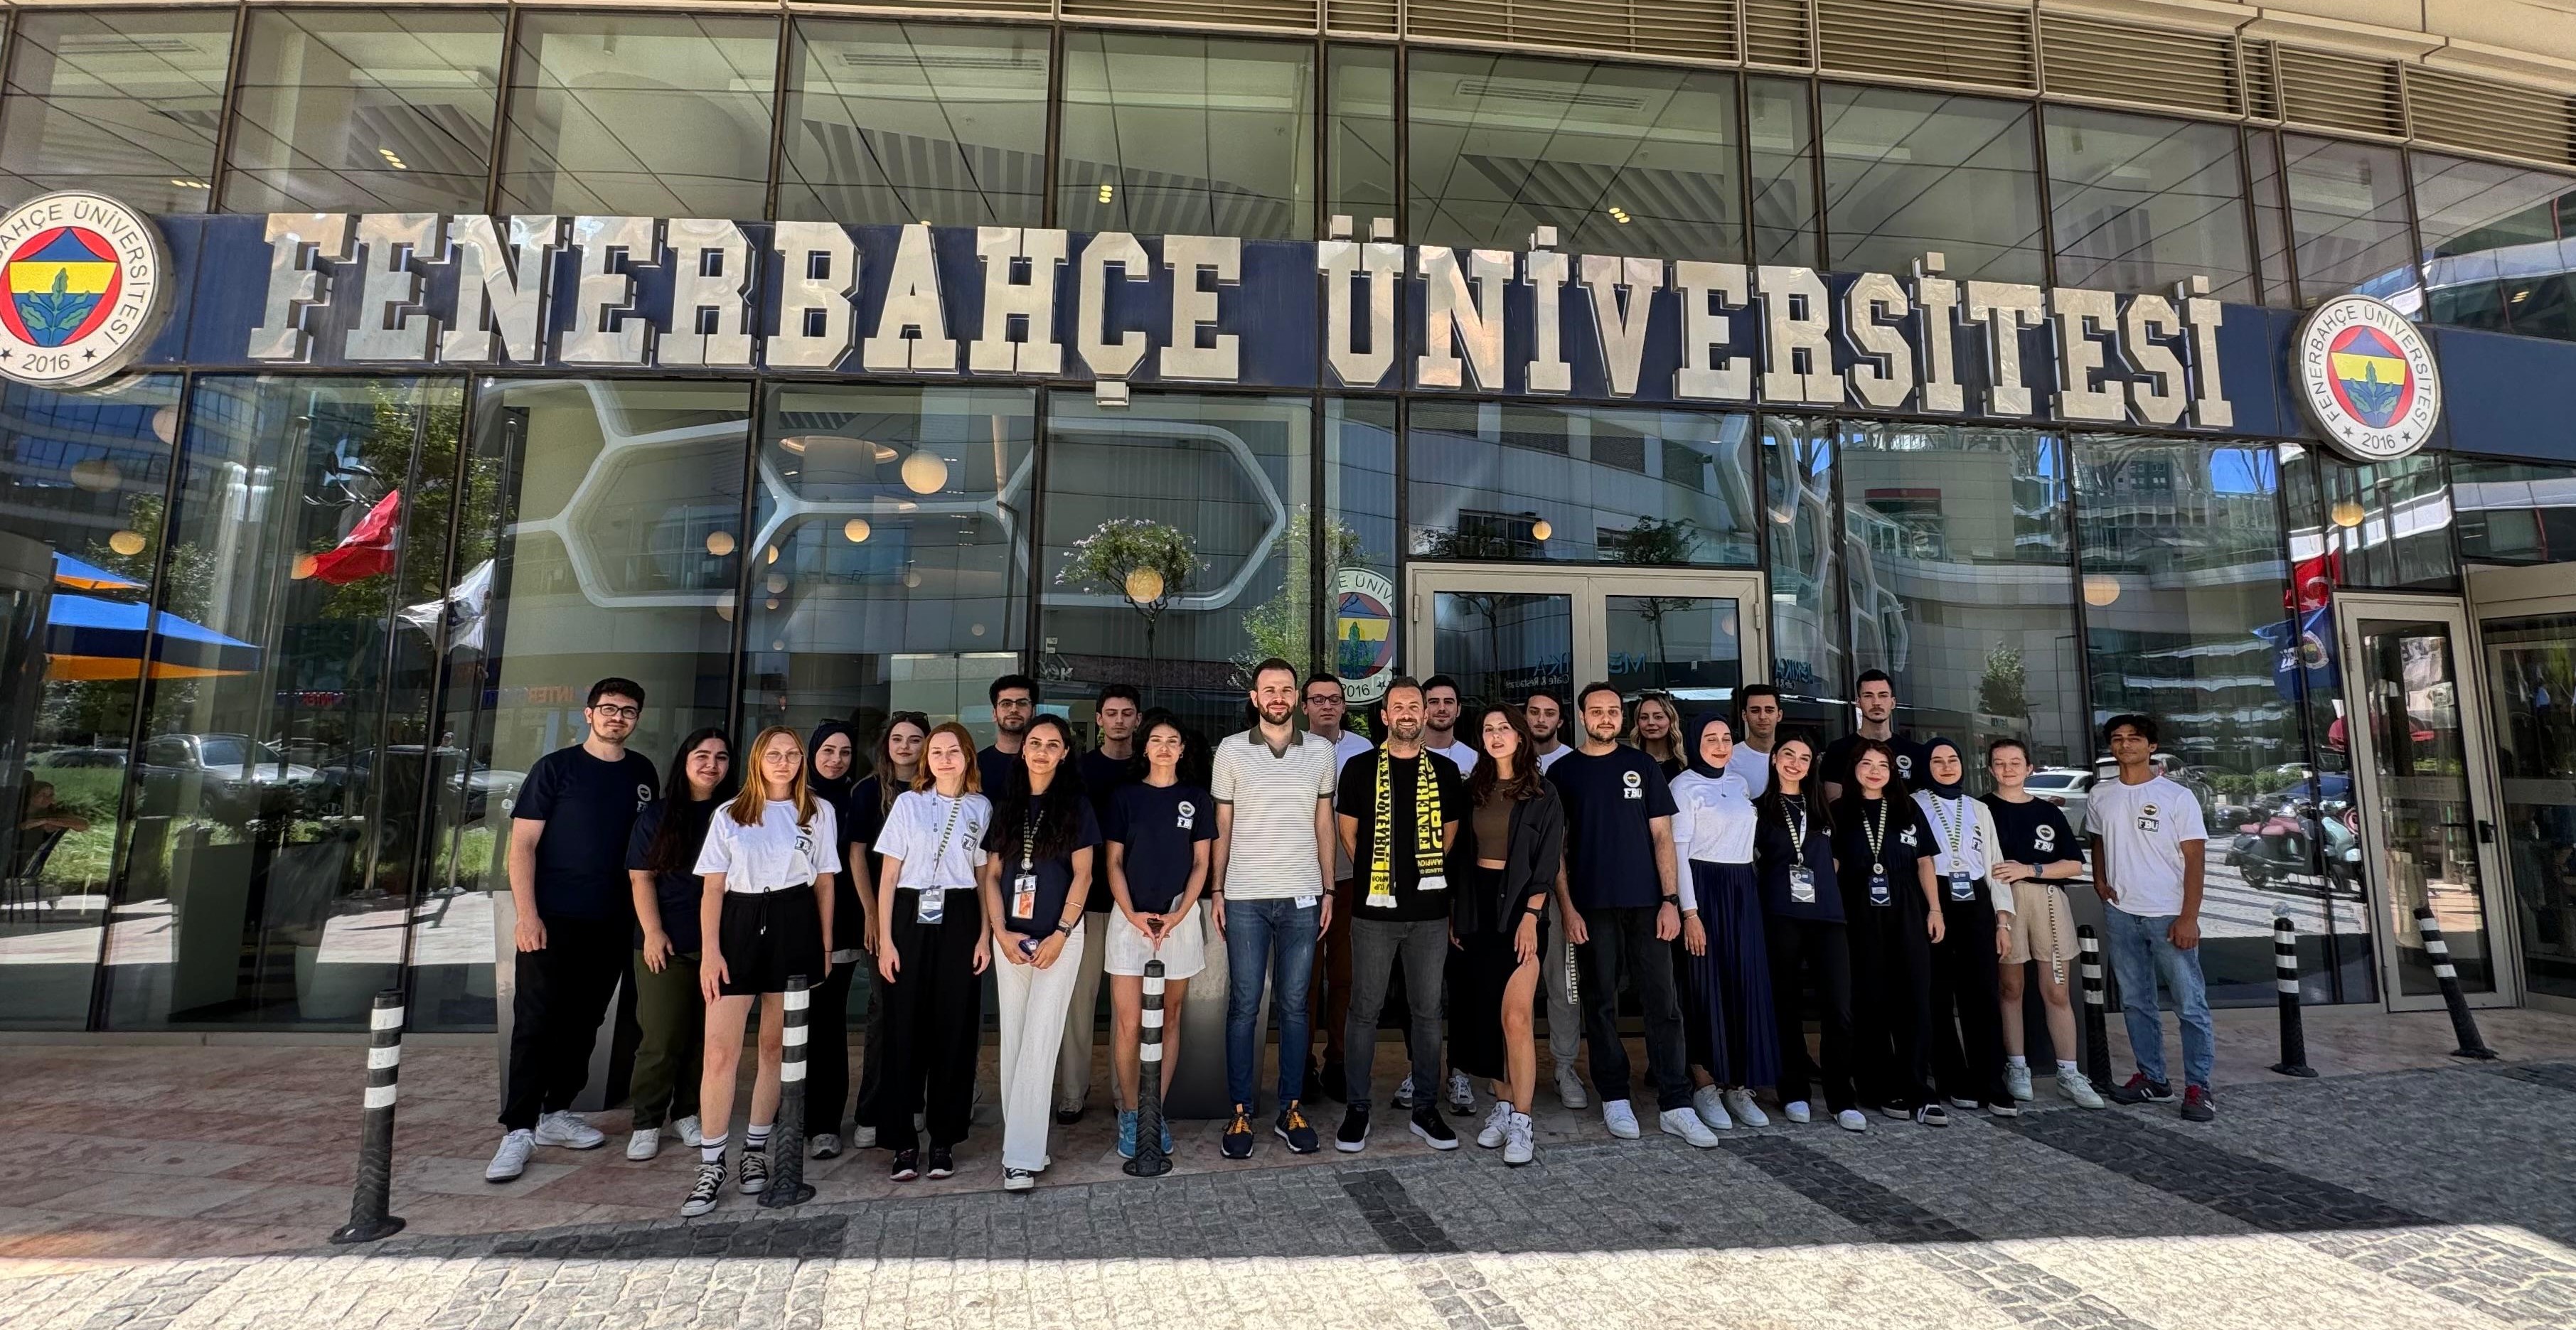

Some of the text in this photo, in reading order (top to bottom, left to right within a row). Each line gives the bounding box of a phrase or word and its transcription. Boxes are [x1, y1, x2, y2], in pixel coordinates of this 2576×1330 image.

[74, 200, 150, 345] ÜNİVERSİTESİ
[248, 213, 2233, 428] FENERBAHÇE ÜNİVERSİTESİ
[22, 353, 70, 372] 2016
[2309, 305, 2358, 422] FENERBAHÇE
[2362, 432, 2395, 450] 2016
